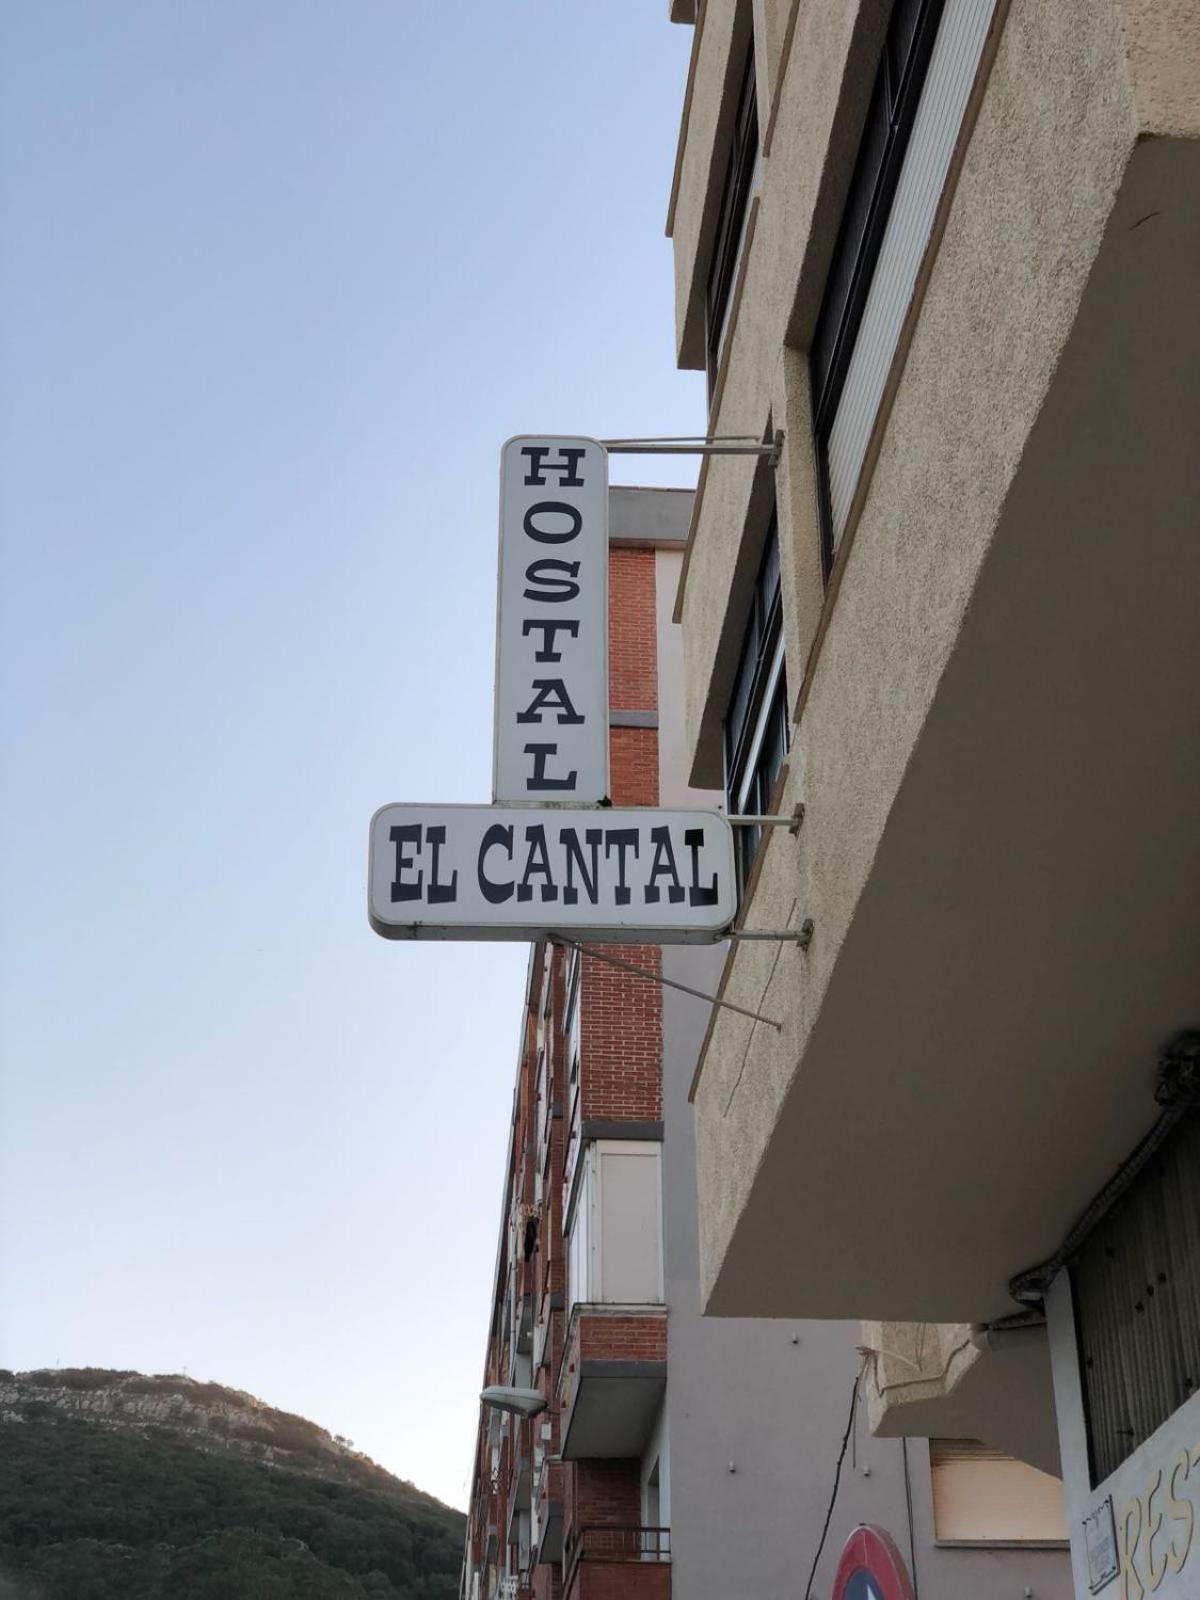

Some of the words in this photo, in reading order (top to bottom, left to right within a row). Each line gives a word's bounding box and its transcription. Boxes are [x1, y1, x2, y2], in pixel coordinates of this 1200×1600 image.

[516, 446, 587, 791] HOSTAL
[388, 823, 458, 905] EL
[477, 823, 719, 908] CANTAL
[1121, 1441, 1200, 1600] RES
